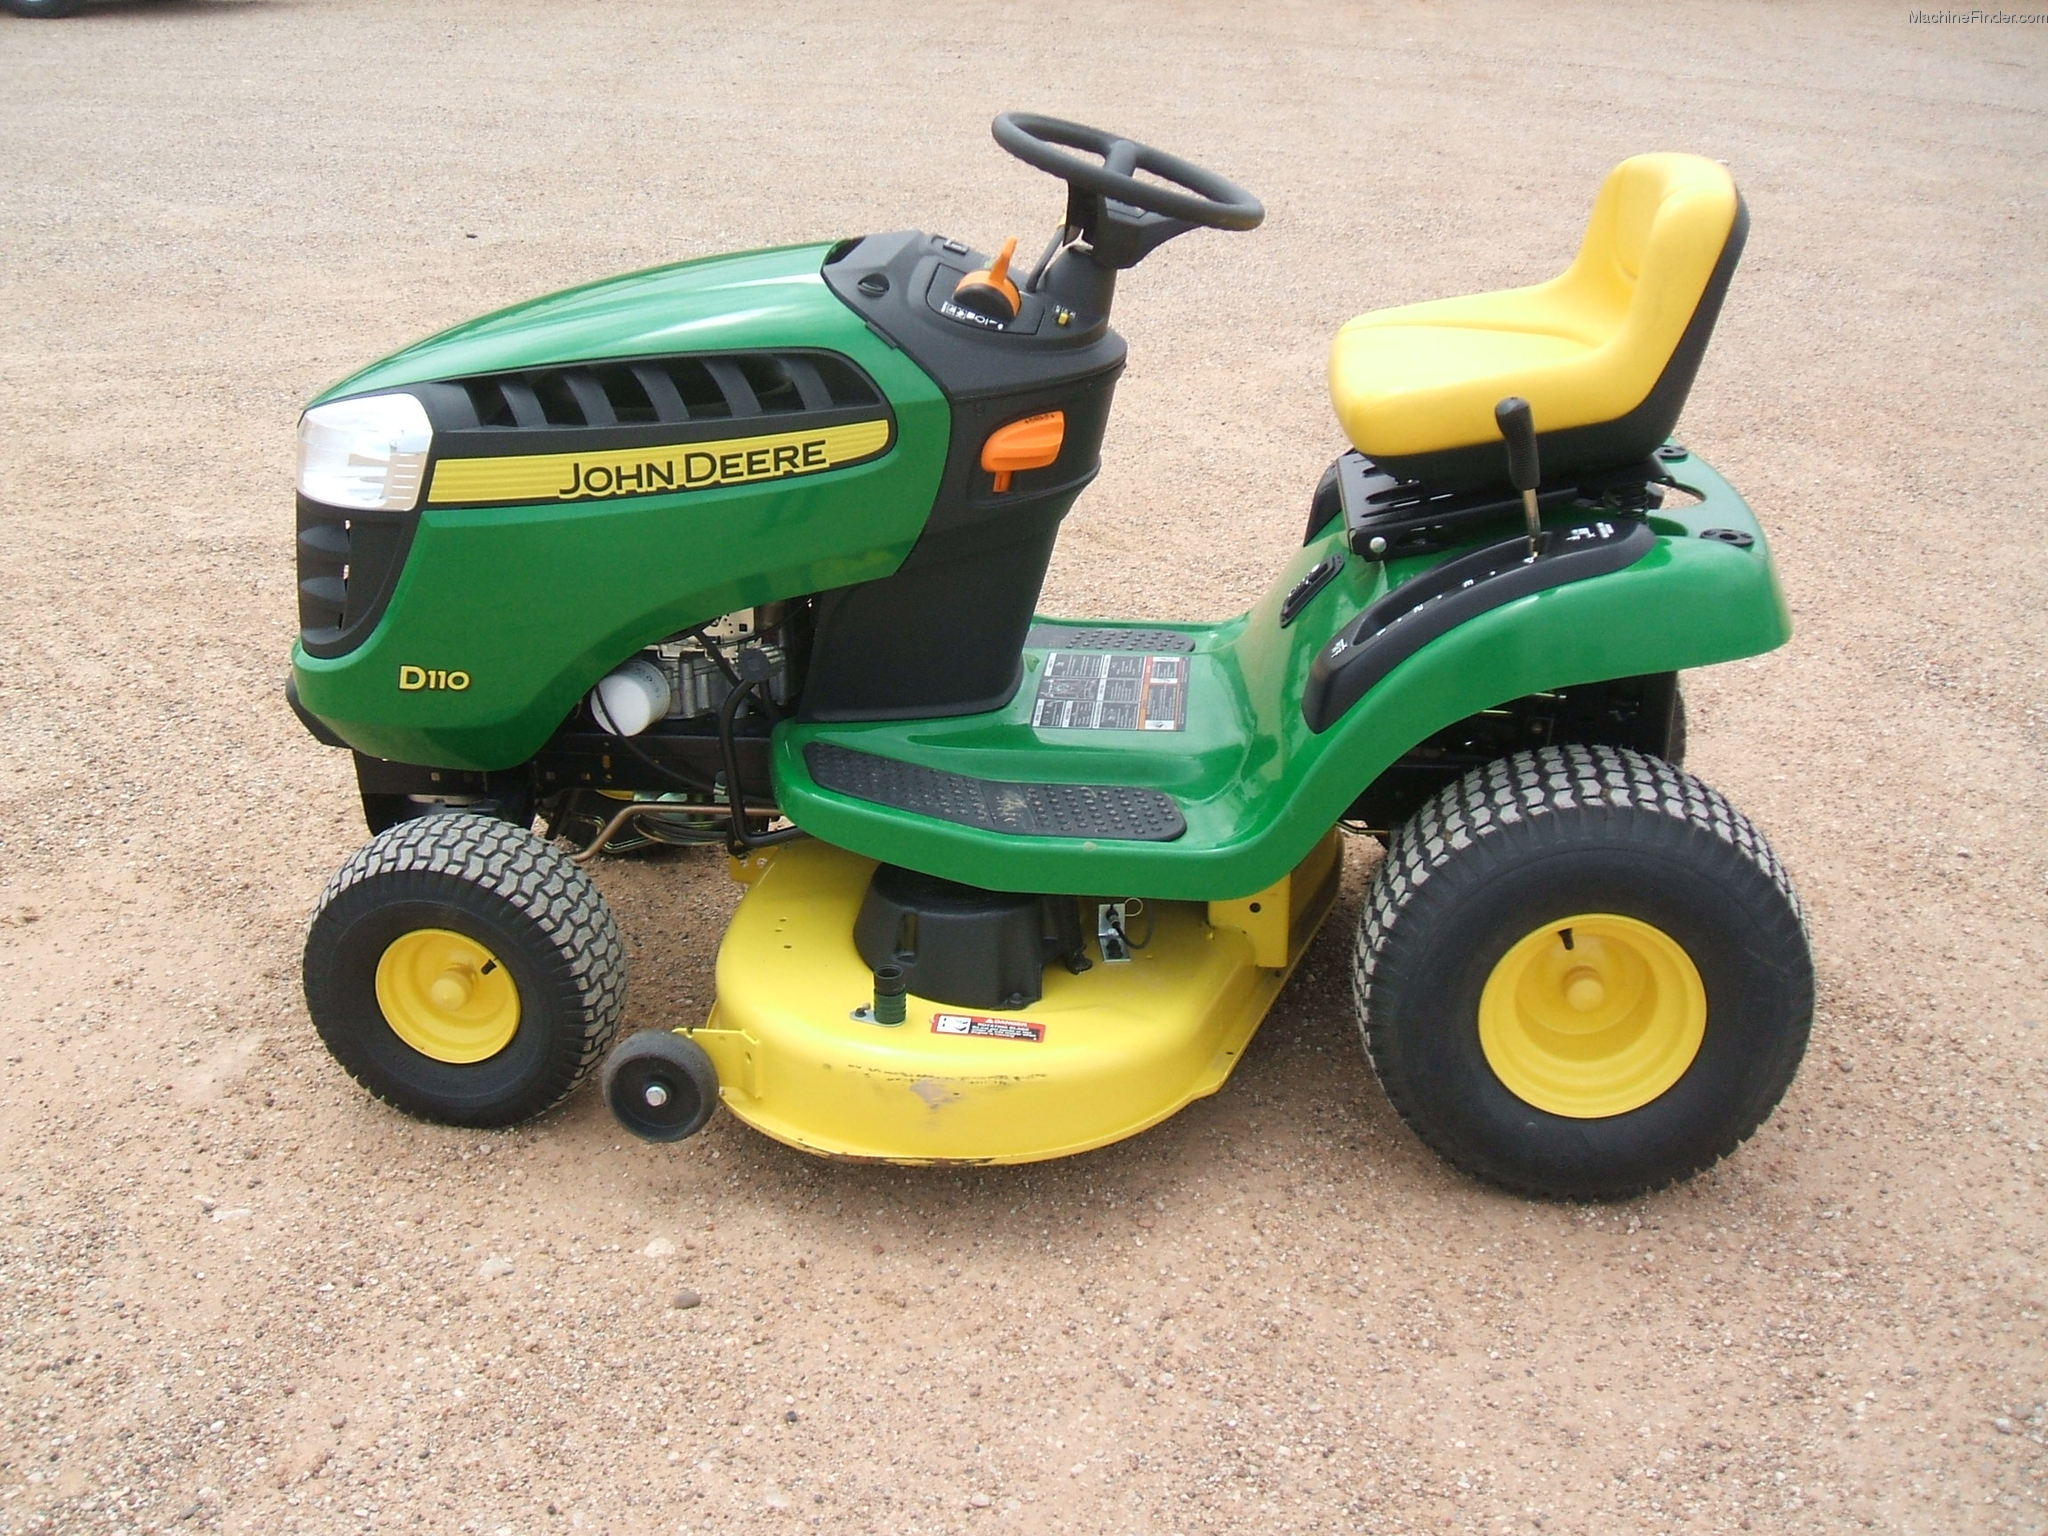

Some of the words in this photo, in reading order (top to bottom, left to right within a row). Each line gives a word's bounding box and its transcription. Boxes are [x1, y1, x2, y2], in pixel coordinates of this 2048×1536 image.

[559, 461, 674, 495] JOHN
[684, 439, 827, 484] DEERE
[399, 665, 471, 691] D110
